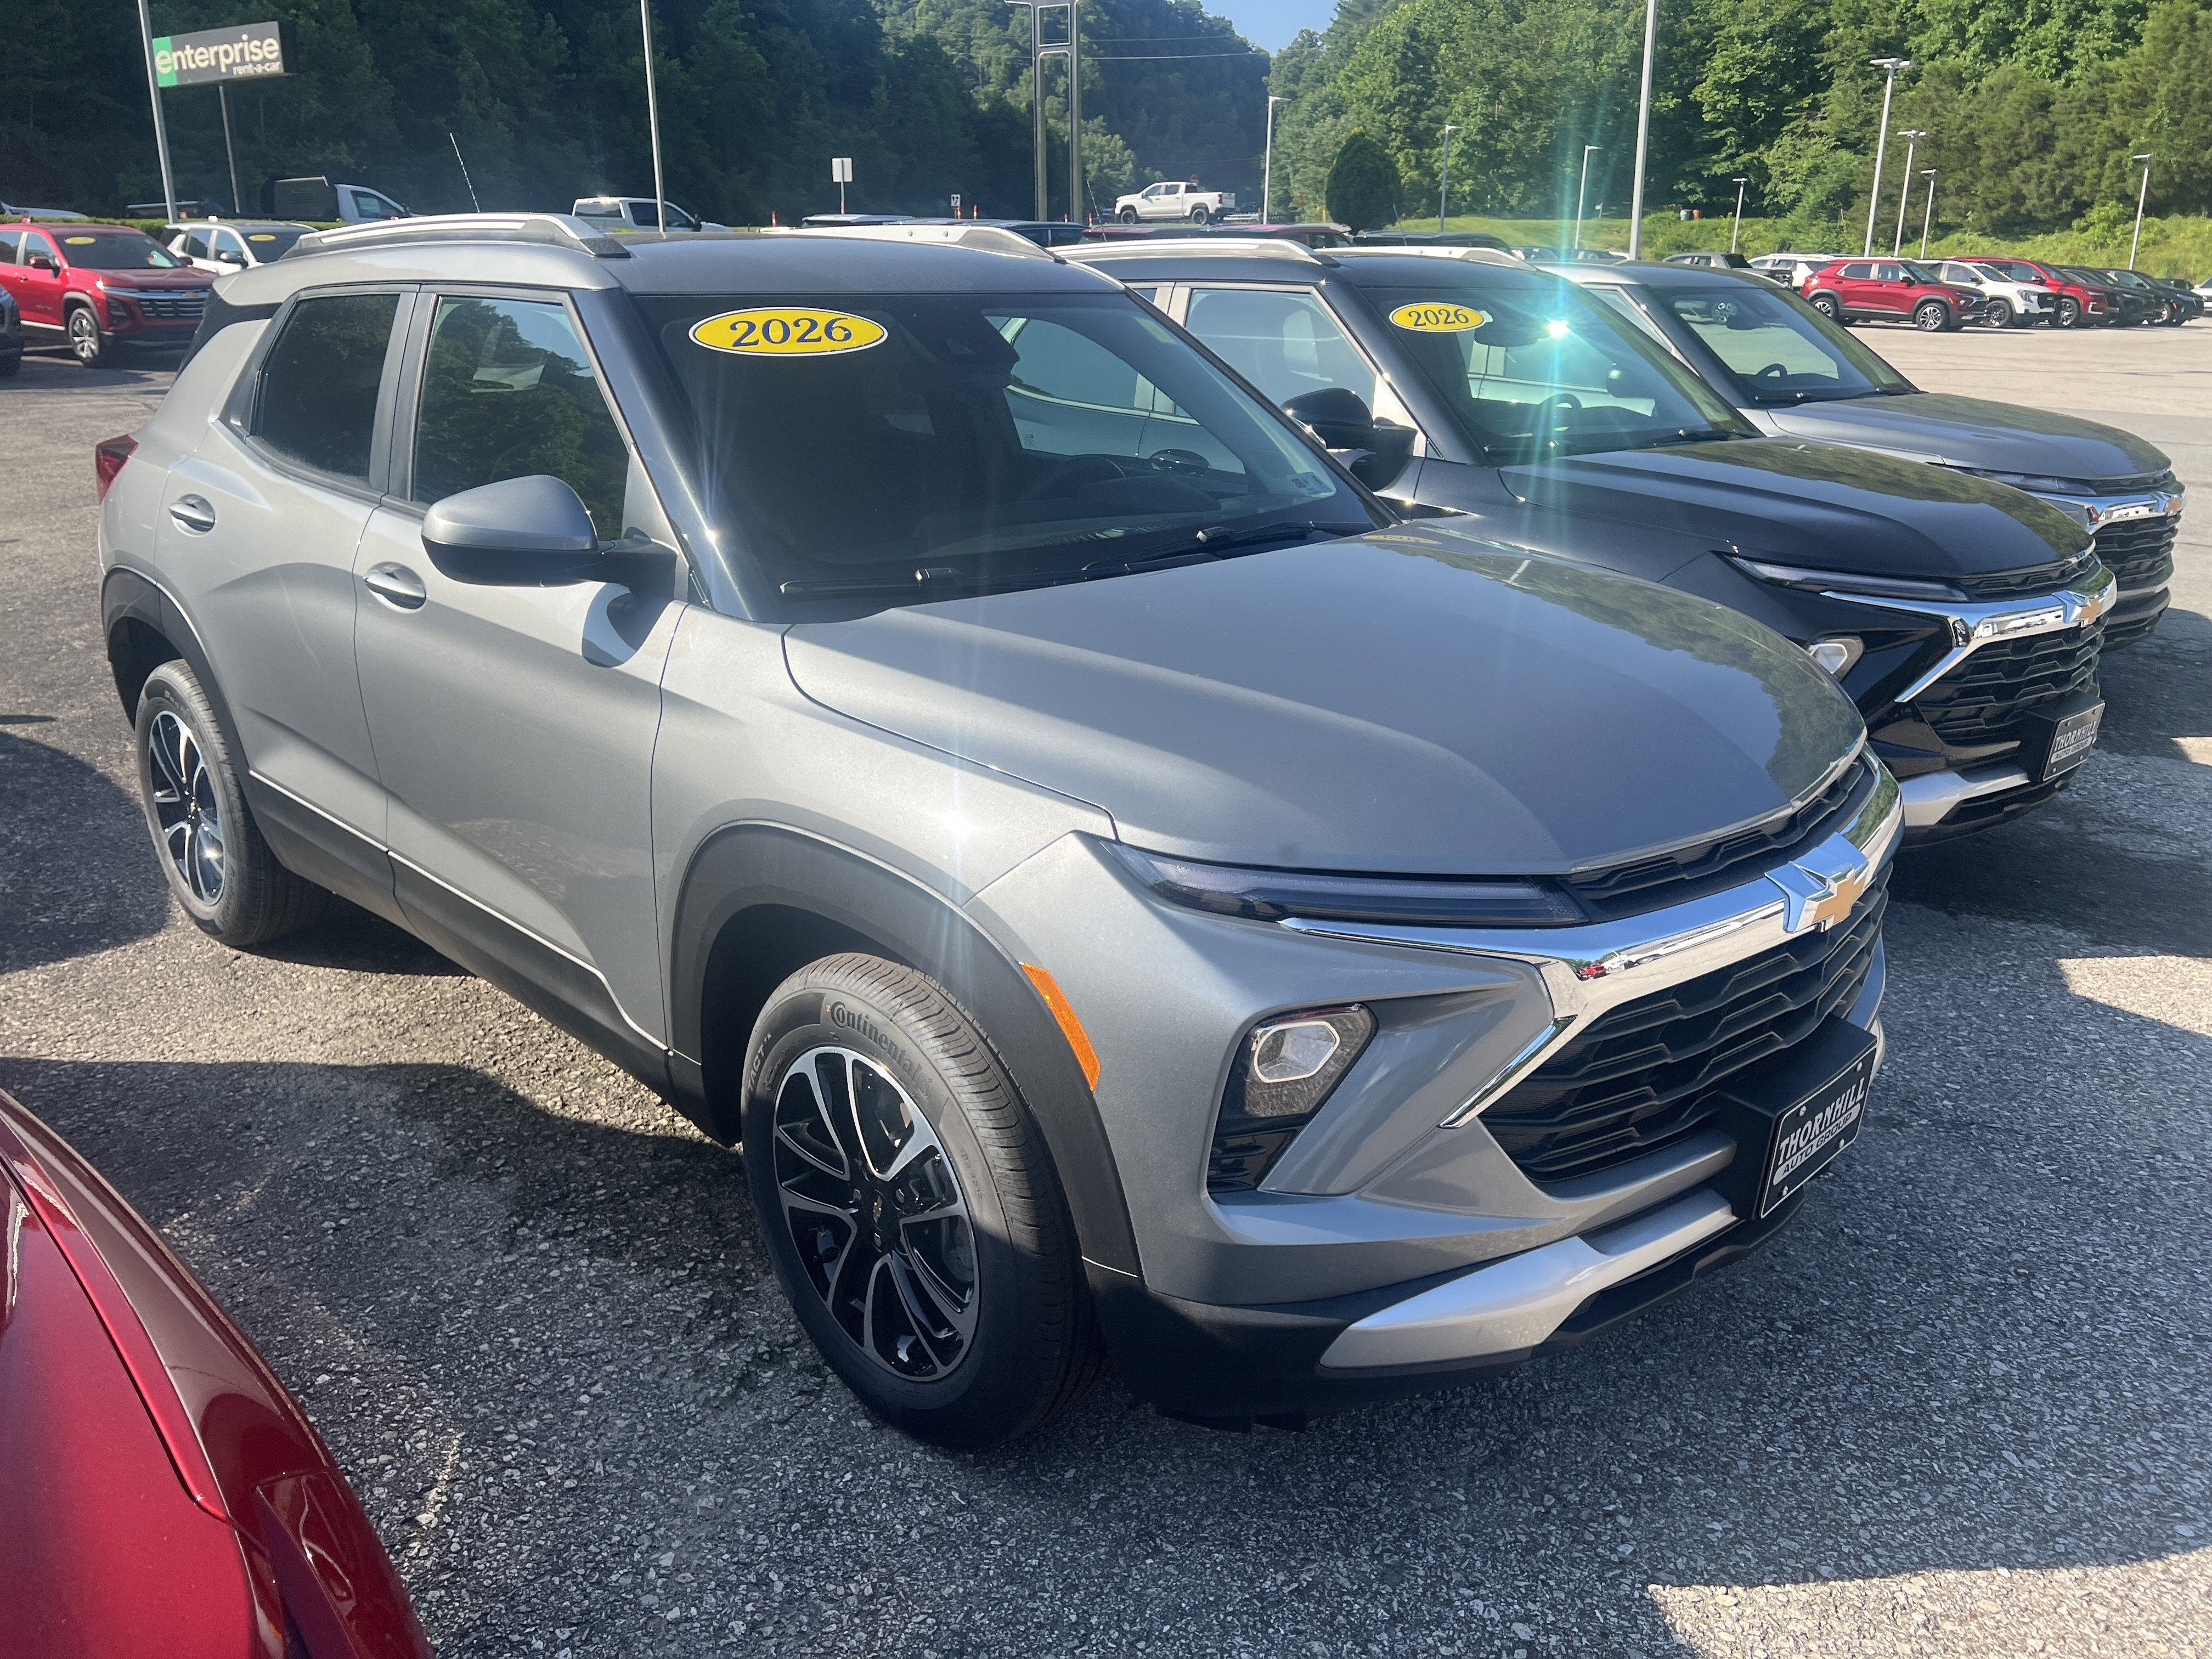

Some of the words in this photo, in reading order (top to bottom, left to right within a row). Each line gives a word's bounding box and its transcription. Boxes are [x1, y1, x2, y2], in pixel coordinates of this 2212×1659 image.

[155, 34, 279, 74] enterprise
[233, 61, 281, 76] rent-a-car
[730, 318, 852, 347] 2026
[1408, 308, 1469, 327] 2026
[2053, 720, 2097, 752] THORNHILL
[830, 1001, 923, 1086] Continental
[1778, 1077, 1865, 1166] THORNHILL
[1782, 1142, 1814, 1177] AUTO
[1816, 1110, 1852, 1149] GROUP
